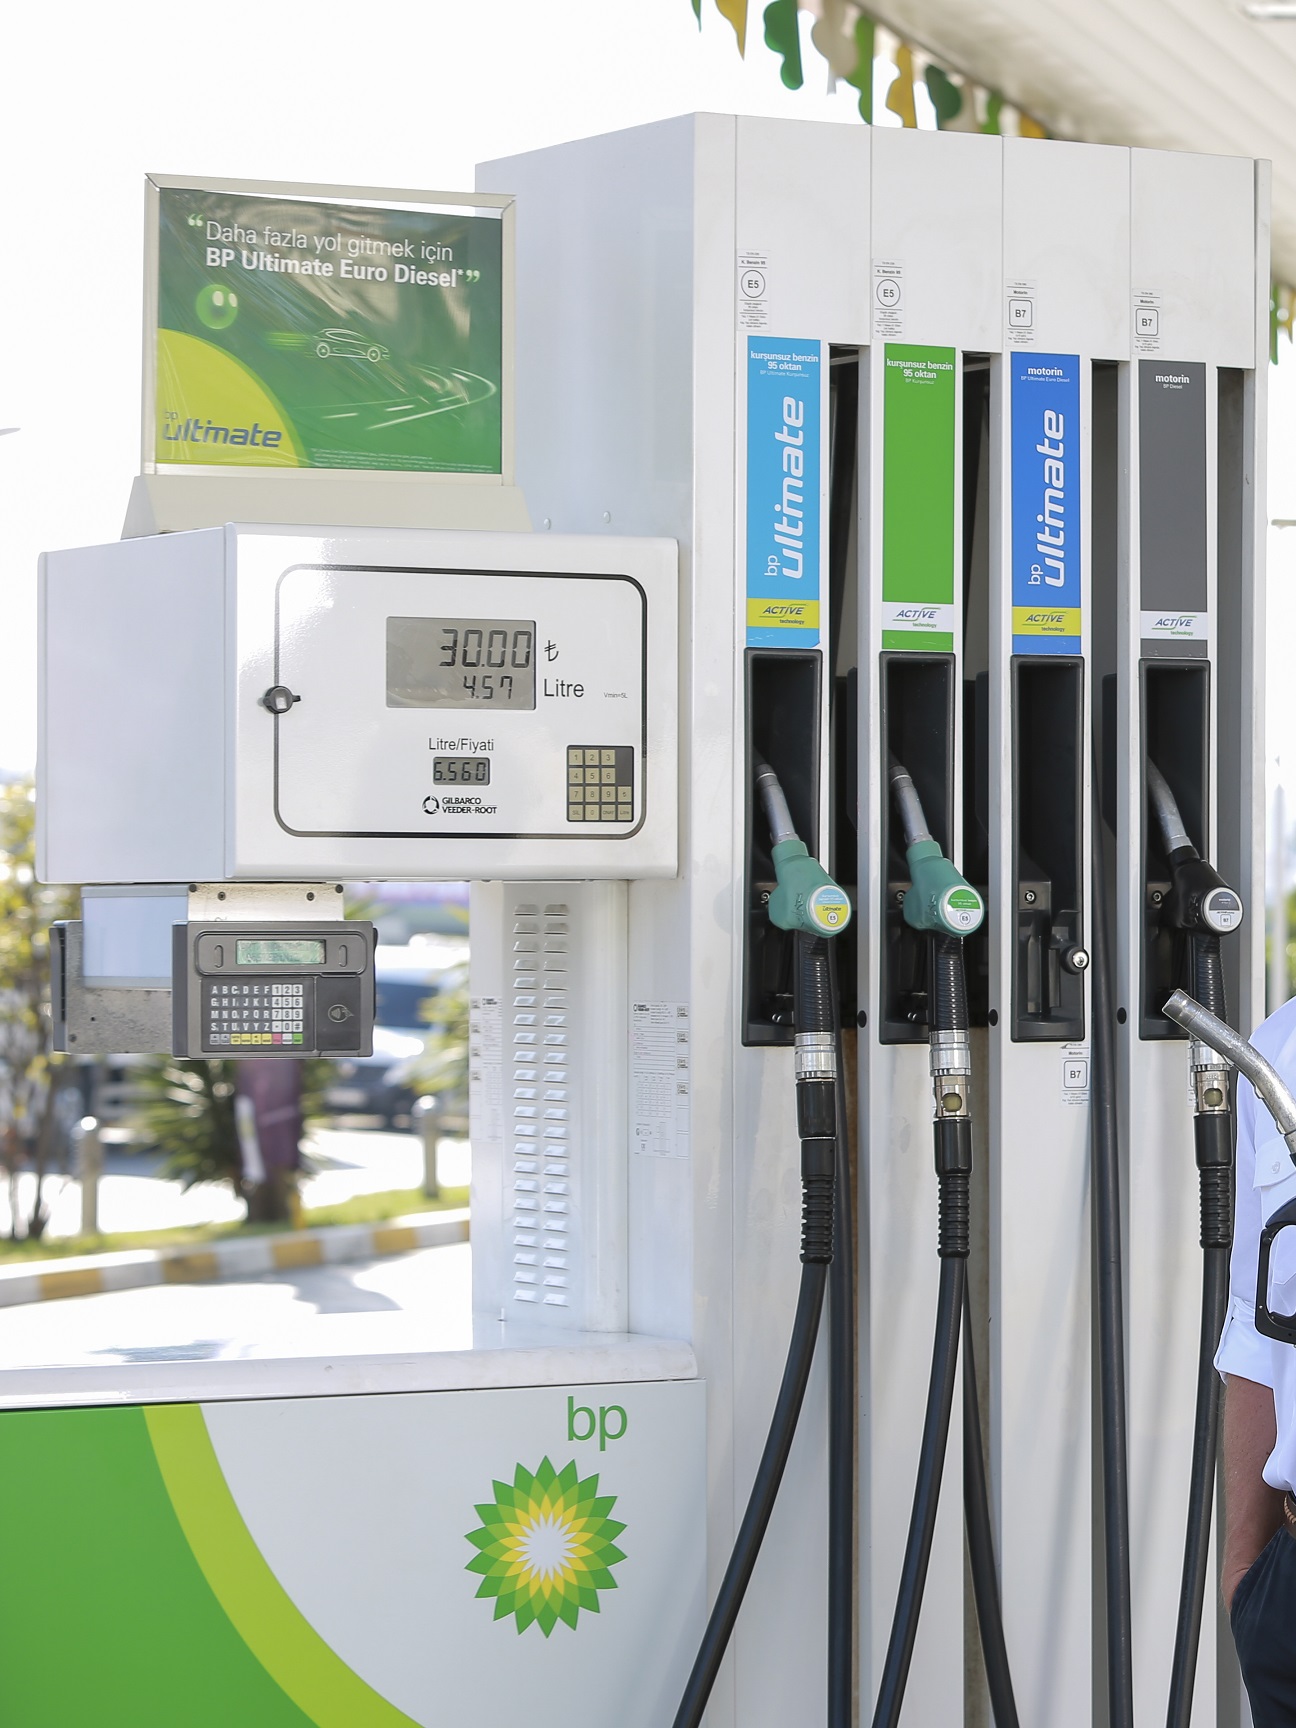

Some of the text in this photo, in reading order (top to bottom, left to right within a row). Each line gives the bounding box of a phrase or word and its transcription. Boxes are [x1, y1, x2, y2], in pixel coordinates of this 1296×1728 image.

[263, 226, 307, 249] fazla
[313, 232, 341, 254] yol
[348, 236, 415, 258] gitmek
[421, 241, 453, 264] için
[206, 248, 235, 268] BP
[241, 250, 334, 277] Ultimate
[340, 260, 388, 282] Euro
[748, 280, 759, 288] E5
[883, 289, 895, 298] E5
[1015, 309, 1026, 318] B7
[1141, 318, 1153, 327] B7
[750, 350, 819, 362] kurşunsuz benzin
[767, 361, 802, 371] 95 oktan
[886, 358, 953, 370] kurşunsuz benzin
[903, 369, 937, 379] 95 oktan
[1027, 366, 1063, 376] motorin
[1155, 374, 1190, 384] motorin
[163, 419, 282, 448] ultimate
[774, 396, 804, 579] ultimate
[1036, 409, 1065, 588] ultimate
[764, 555, 781, 576] bp
[1028, 564, 1044, 585] bp
[762, 605, 805, 616] ACTIVE
[896, 608, 937, 619] ACTIVE
[1025, 613, 1066, 623] ACTIVE
[1155, 617, 1193, 627] ACTIVE
[439, 629, 532, 668] 30.00
[463, 675, 585, 700] 4.57 Litre
[442, 797, 481, 805] GILBARCO
[442, 806, 497, 814] VEEDER-ROOT
[1070, 1070, 1081, 1079] B7
[567, 1396, 628, 1451] bp
